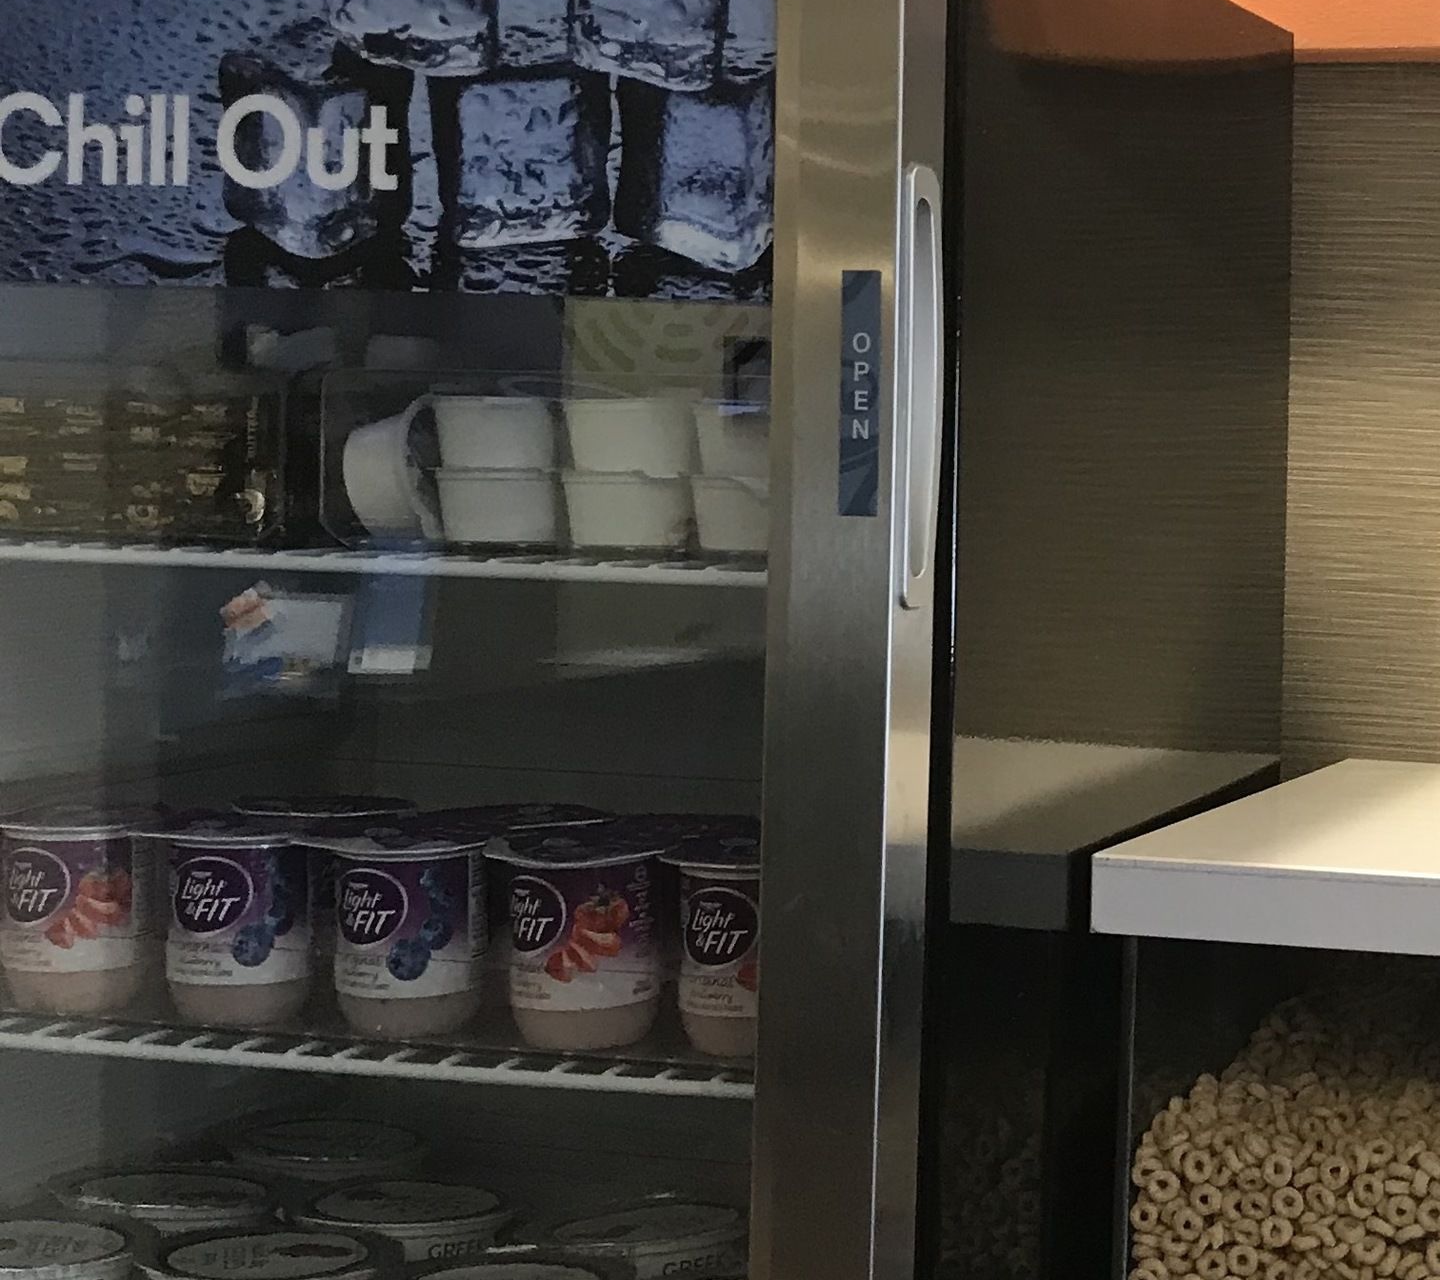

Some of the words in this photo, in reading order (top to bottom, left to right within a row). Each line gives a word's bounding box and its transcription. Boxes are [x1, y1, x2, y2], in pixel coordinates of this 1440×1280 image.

[0, 91, 190, 186] Chill
[216, 93, 399, 191] Out
[851, 332, 872, 440] OPEN
[18, 888, 58, 912] FIT
[181, 877, 228, 901] Light
[343, 887, 384, 912] Light
[194, 897, 241, 922] FIT
[353, 909, 396, 935] FIT
[691, 908, 736, 933] Light
[517, 917, 554, 942] FIT
[703, 930, 748, 955] FIT
